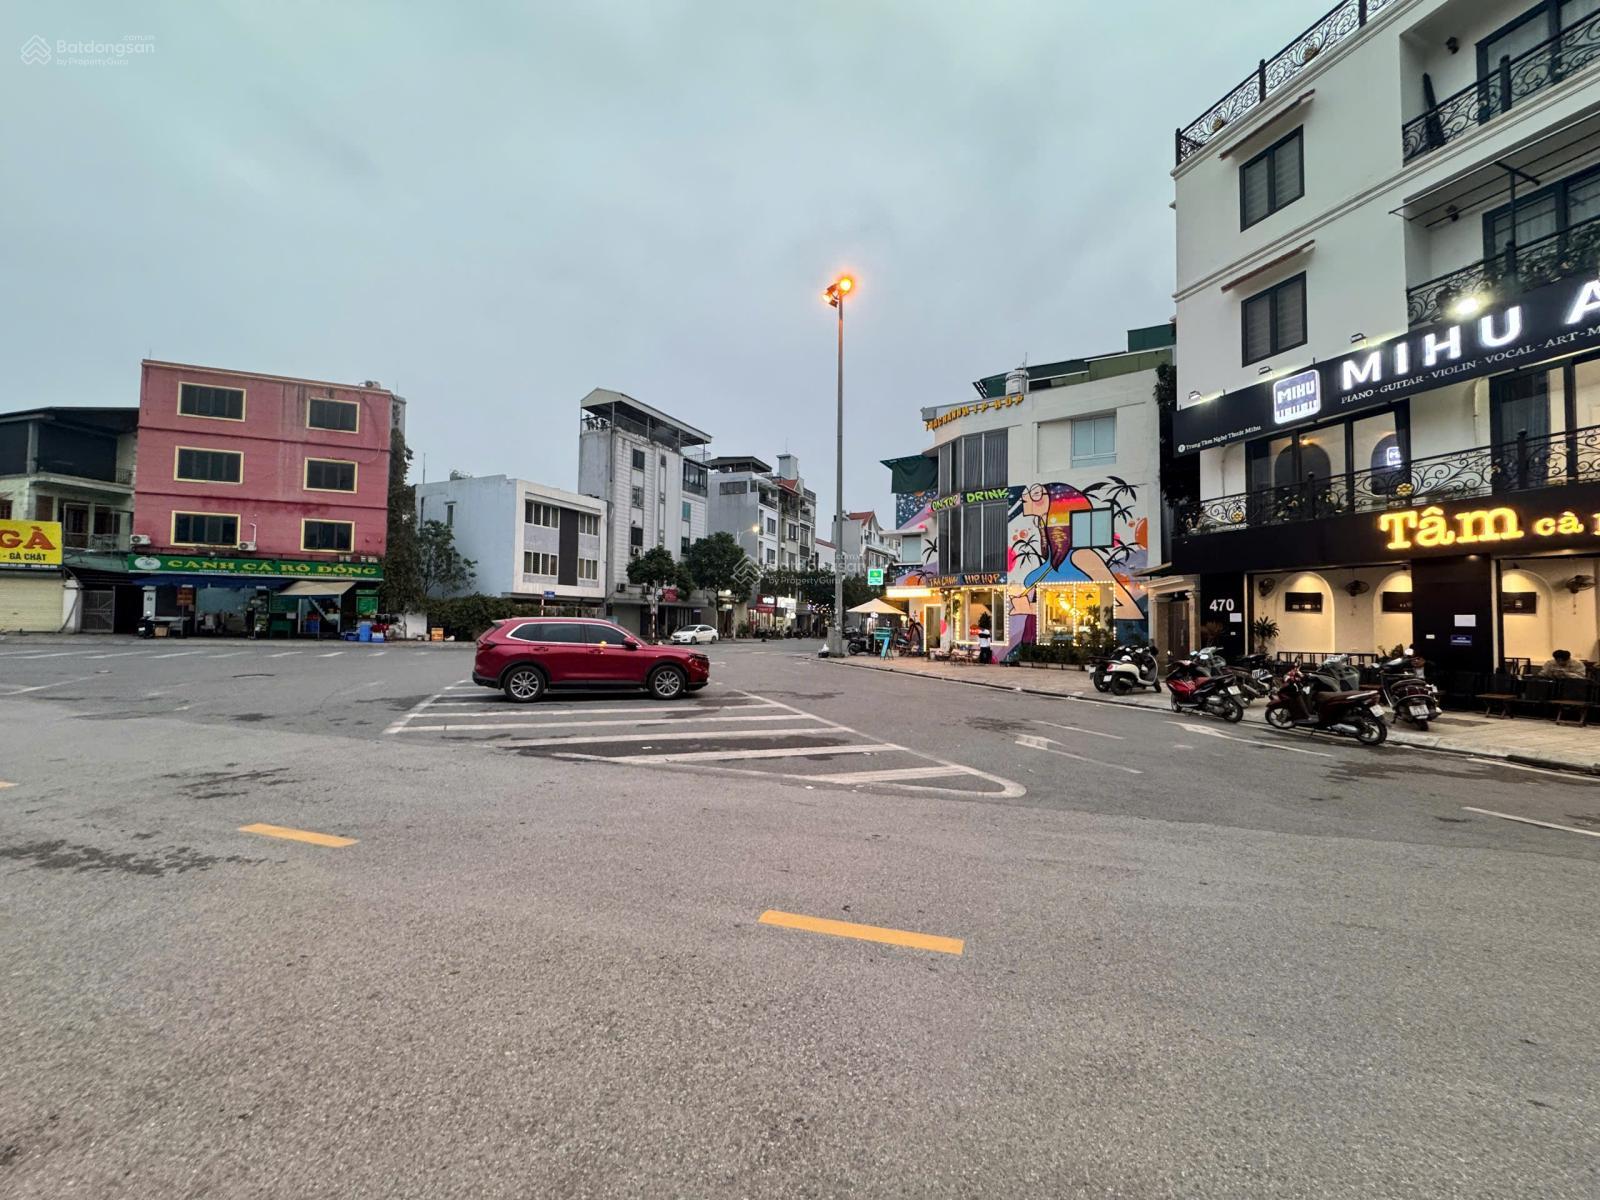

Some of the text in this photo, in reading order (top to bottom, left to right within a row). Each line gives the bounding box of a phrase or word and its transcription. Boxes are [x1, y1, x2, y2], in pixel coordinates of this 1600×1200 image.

[1342, 305, 1522, 391] MIHU
[1341, 388, 1374, 404] PIANO
[1380, 375, 1424, 393] GUITAR
[1432, 360, 1477, 378] VIOLIN
[1484, 345, 1536, 363] VOCAL
[1543, 331, 1580, 349] ART
[1277, 380, 1315, 404] MIHU
[966, 488, 1009, 503] DRINK
[1379, 506, 1525, 550] Tâm
[1534, 511, 1584, 537] cà
[167, 559, 235, 570] CANH
[963, 574, 980, 585] HIP
[981, 573, 1000, 584] HOP
[1209, 598, 1235, 612] 470
